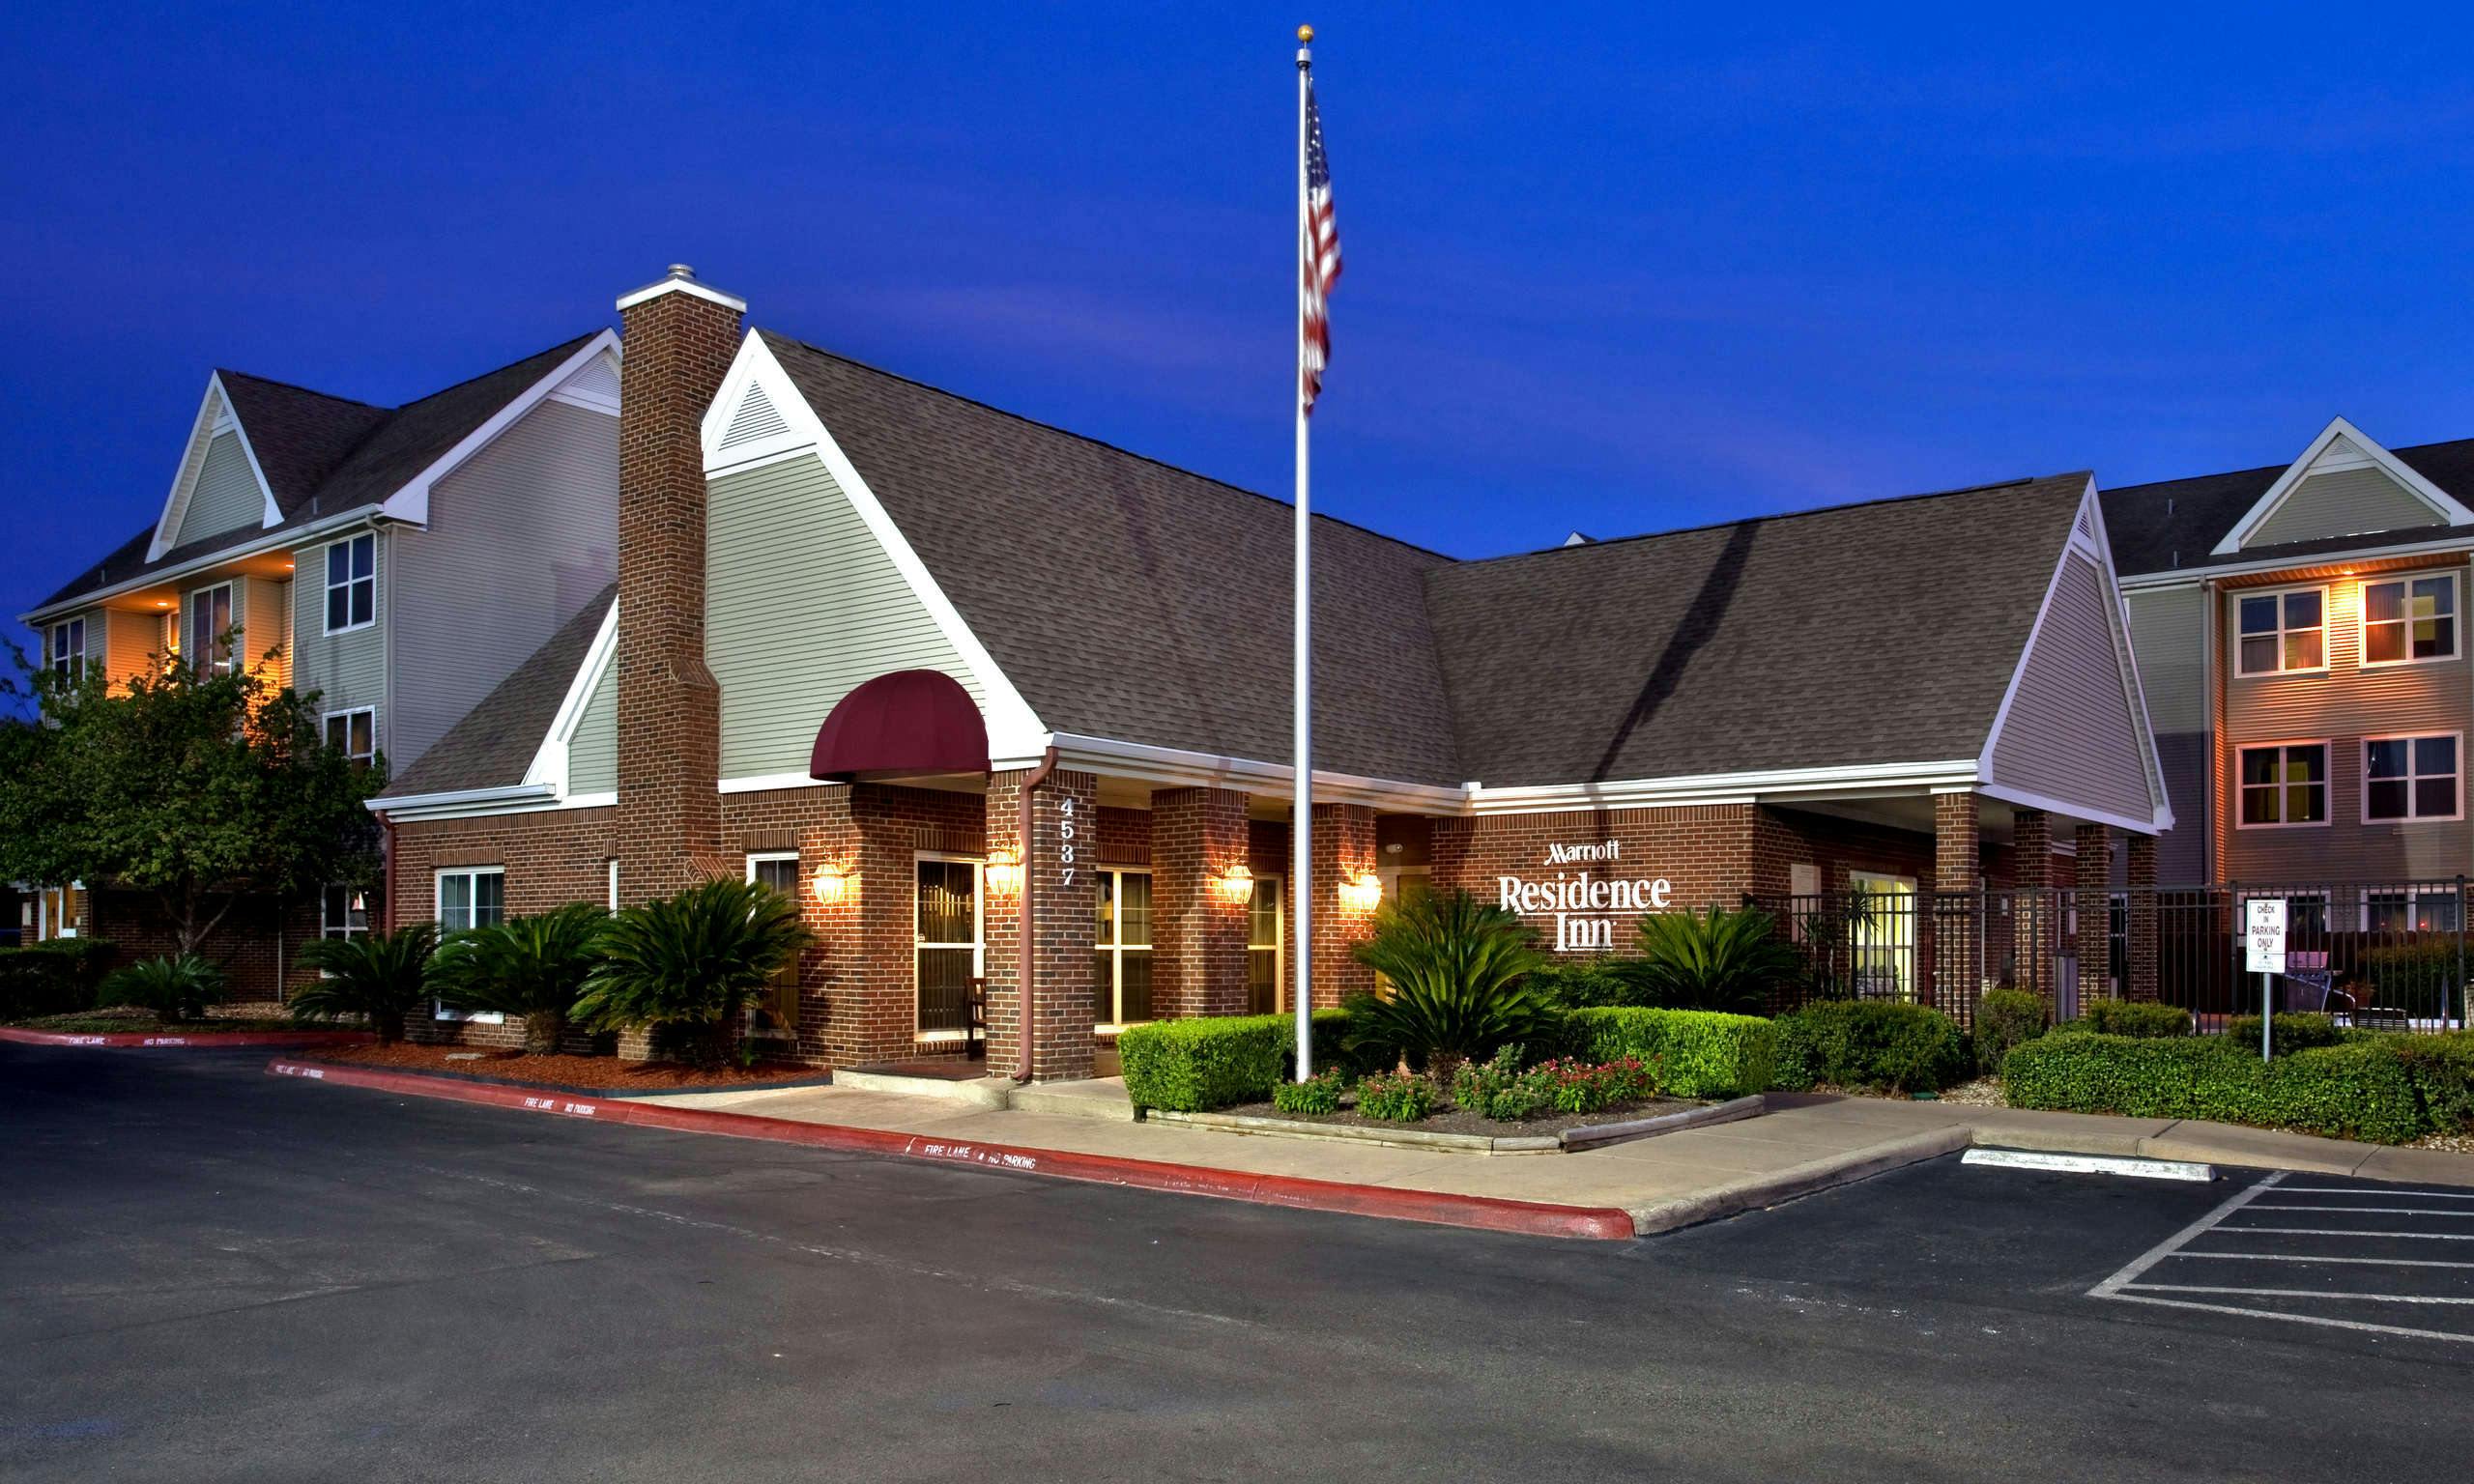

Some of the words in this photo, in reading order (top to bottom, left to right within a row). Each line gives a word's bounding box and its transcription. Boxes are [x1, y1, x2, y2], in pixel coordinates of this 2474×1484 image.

[1060, 798, 1075, 886] 4537
[1543, 839, 1620, 866] Marriott
[1497, 871, 1671, 913] Residence
[1554, 912, 1613, 952] Inn
[2252, 926, 2280, 935] PARKING
[2258, 938, 2273, 947] ONLY
[525, 1098, 537, 1107] FIRE
[925, 1144, 944, 1156] FIRE
[946, 1147, 971, 1158] LANE
[1001, 1154, 1036, 1170] PARKING
